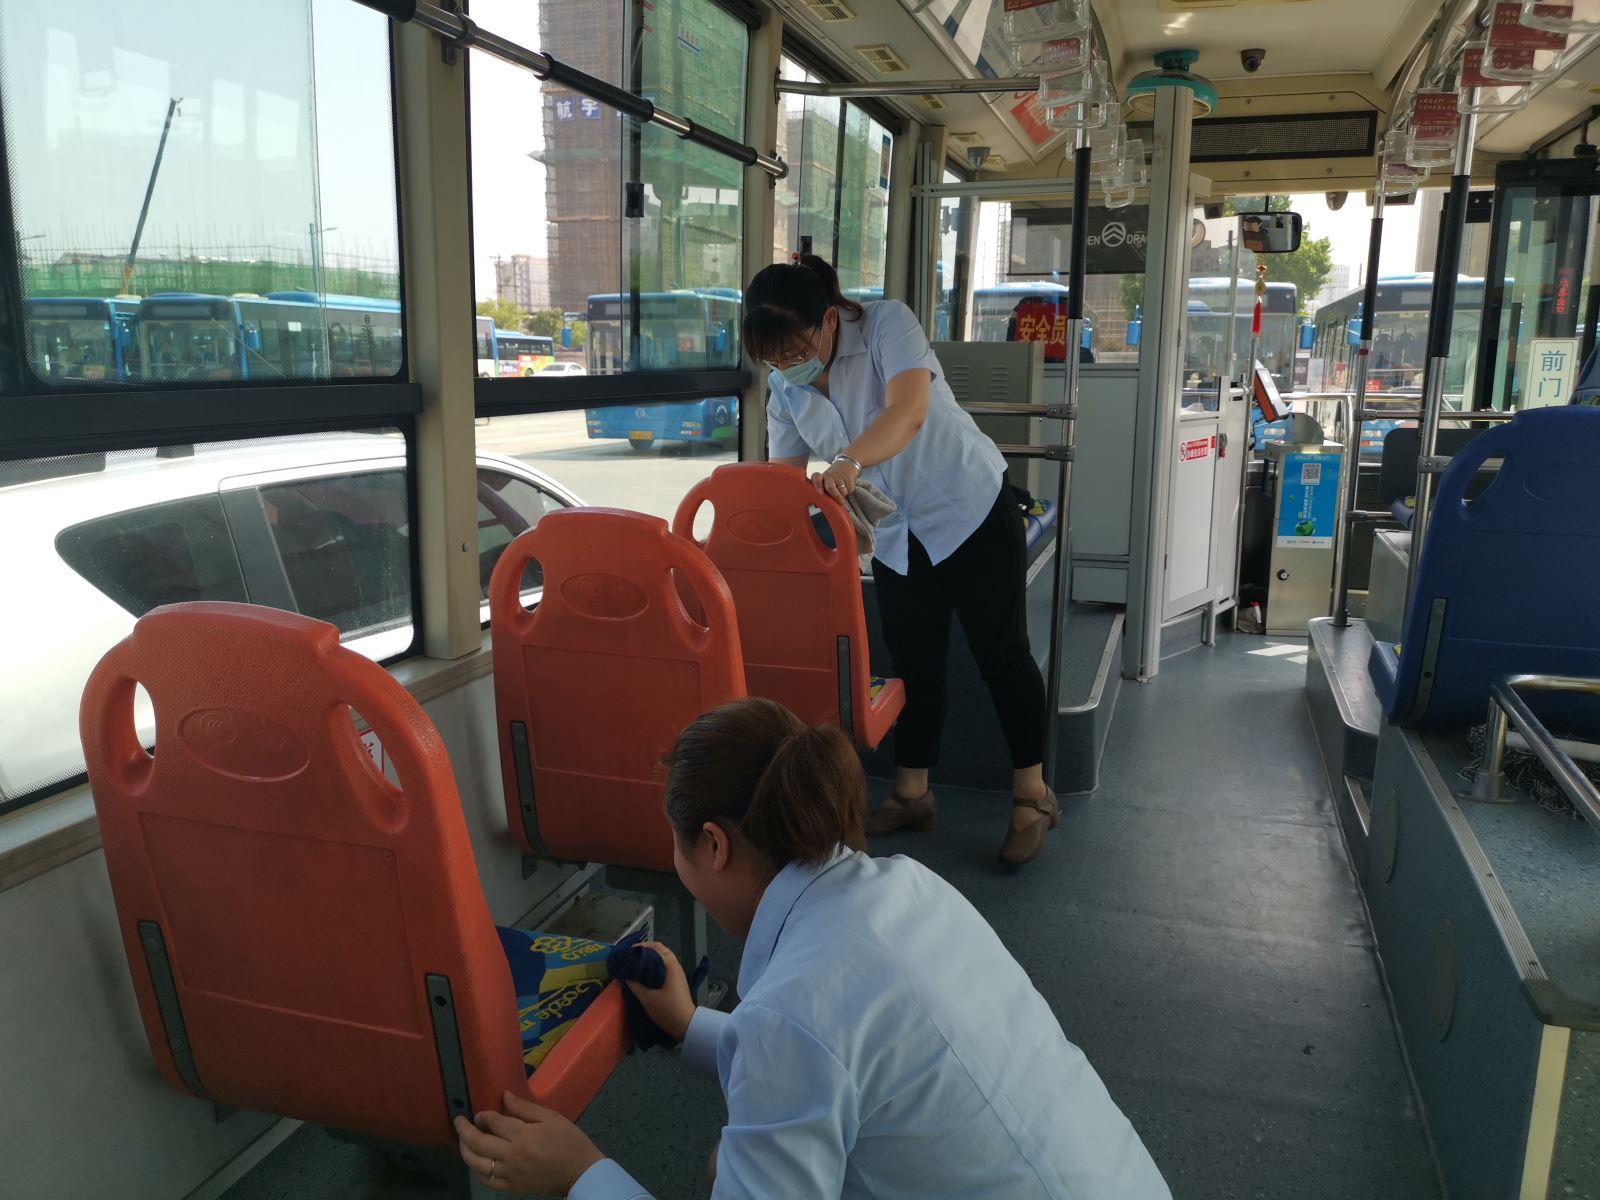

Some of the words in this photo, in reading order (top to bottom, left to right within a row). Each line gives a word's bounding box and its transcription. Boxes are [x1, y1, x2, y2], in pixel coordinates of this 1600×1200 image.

[1087, 235, 1101, 246] EN
[1126, 233, 1148, 245] DRA
[1019, 314, 1066, 346] 安全员
[1537, 350, 1567, 406] 前门
